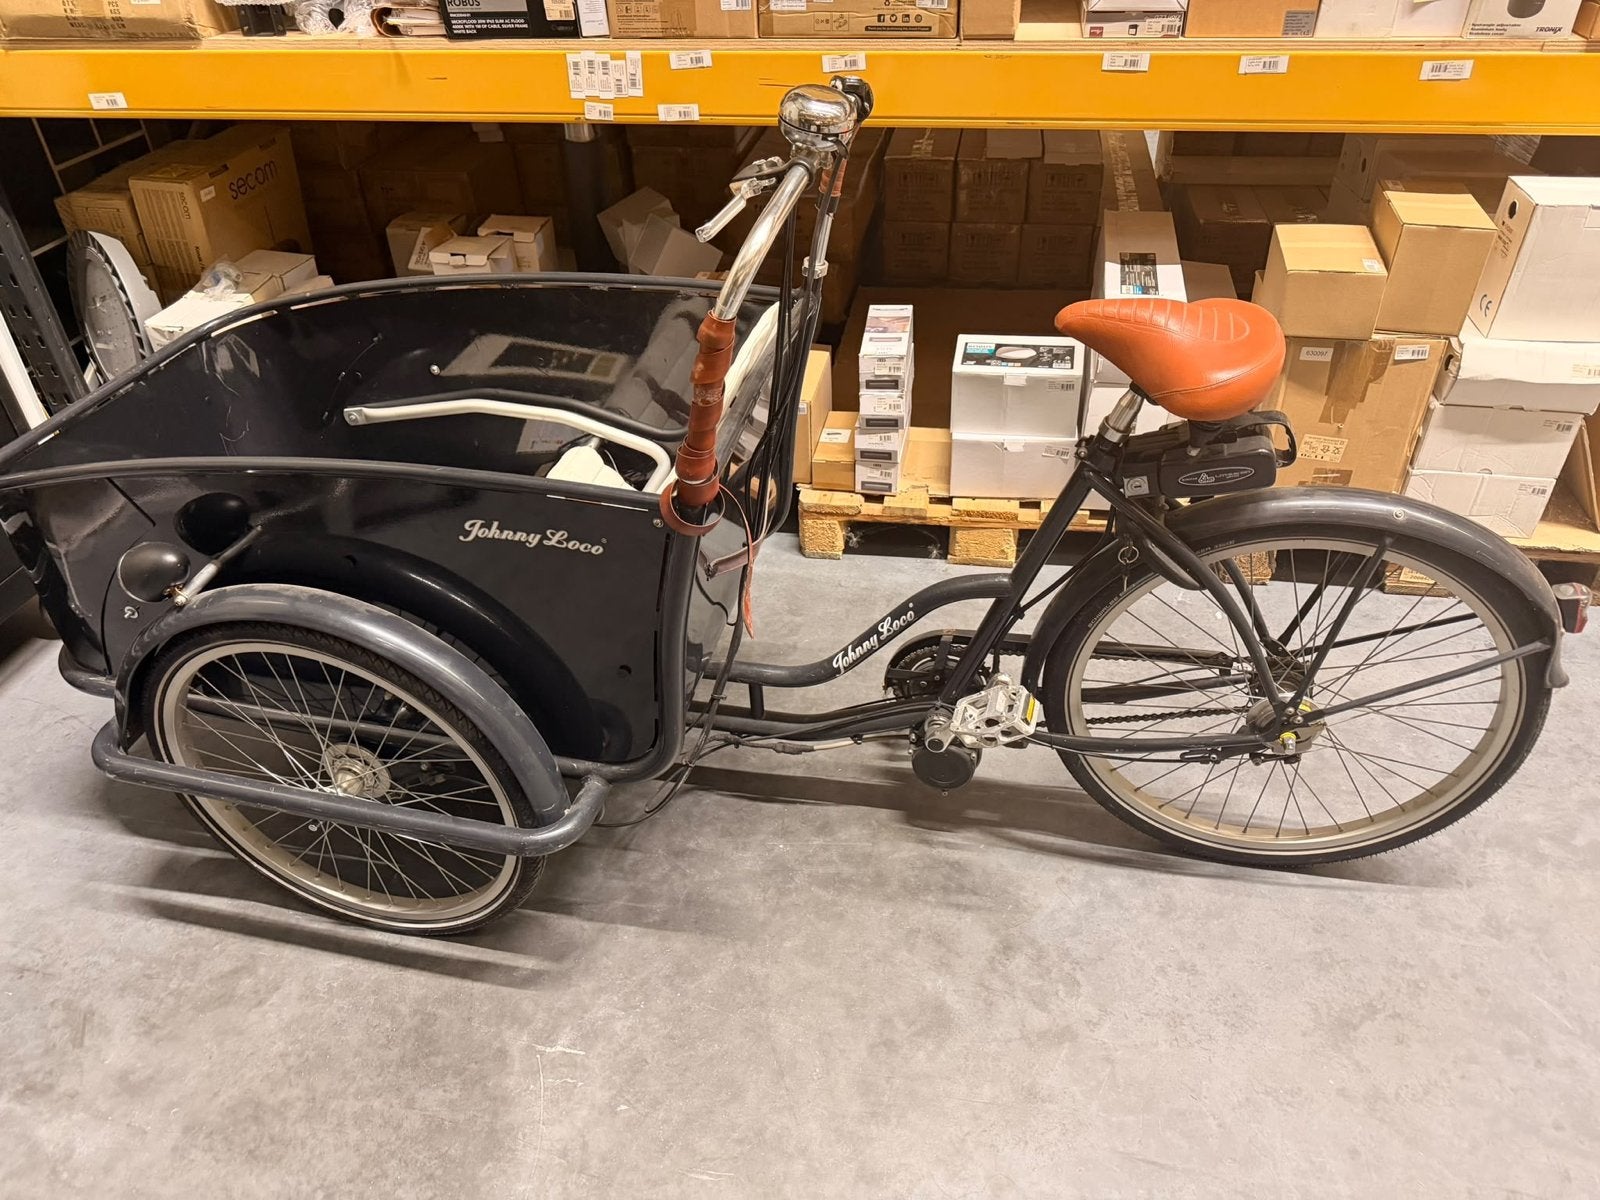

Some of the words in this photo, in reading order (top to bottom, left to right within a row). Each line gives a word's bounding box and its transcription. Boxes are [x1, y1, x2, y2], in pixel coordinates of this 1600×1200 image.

[1535, 26, 1563, 34] TRONIX
[229, 160, 278, 200] secom
[459, 519, 543, 548] Johnny
[543, 529, 604, 555] Loco
[832, 633, 879, 676] Johnny
[877, 611, 915, 641] Loco
